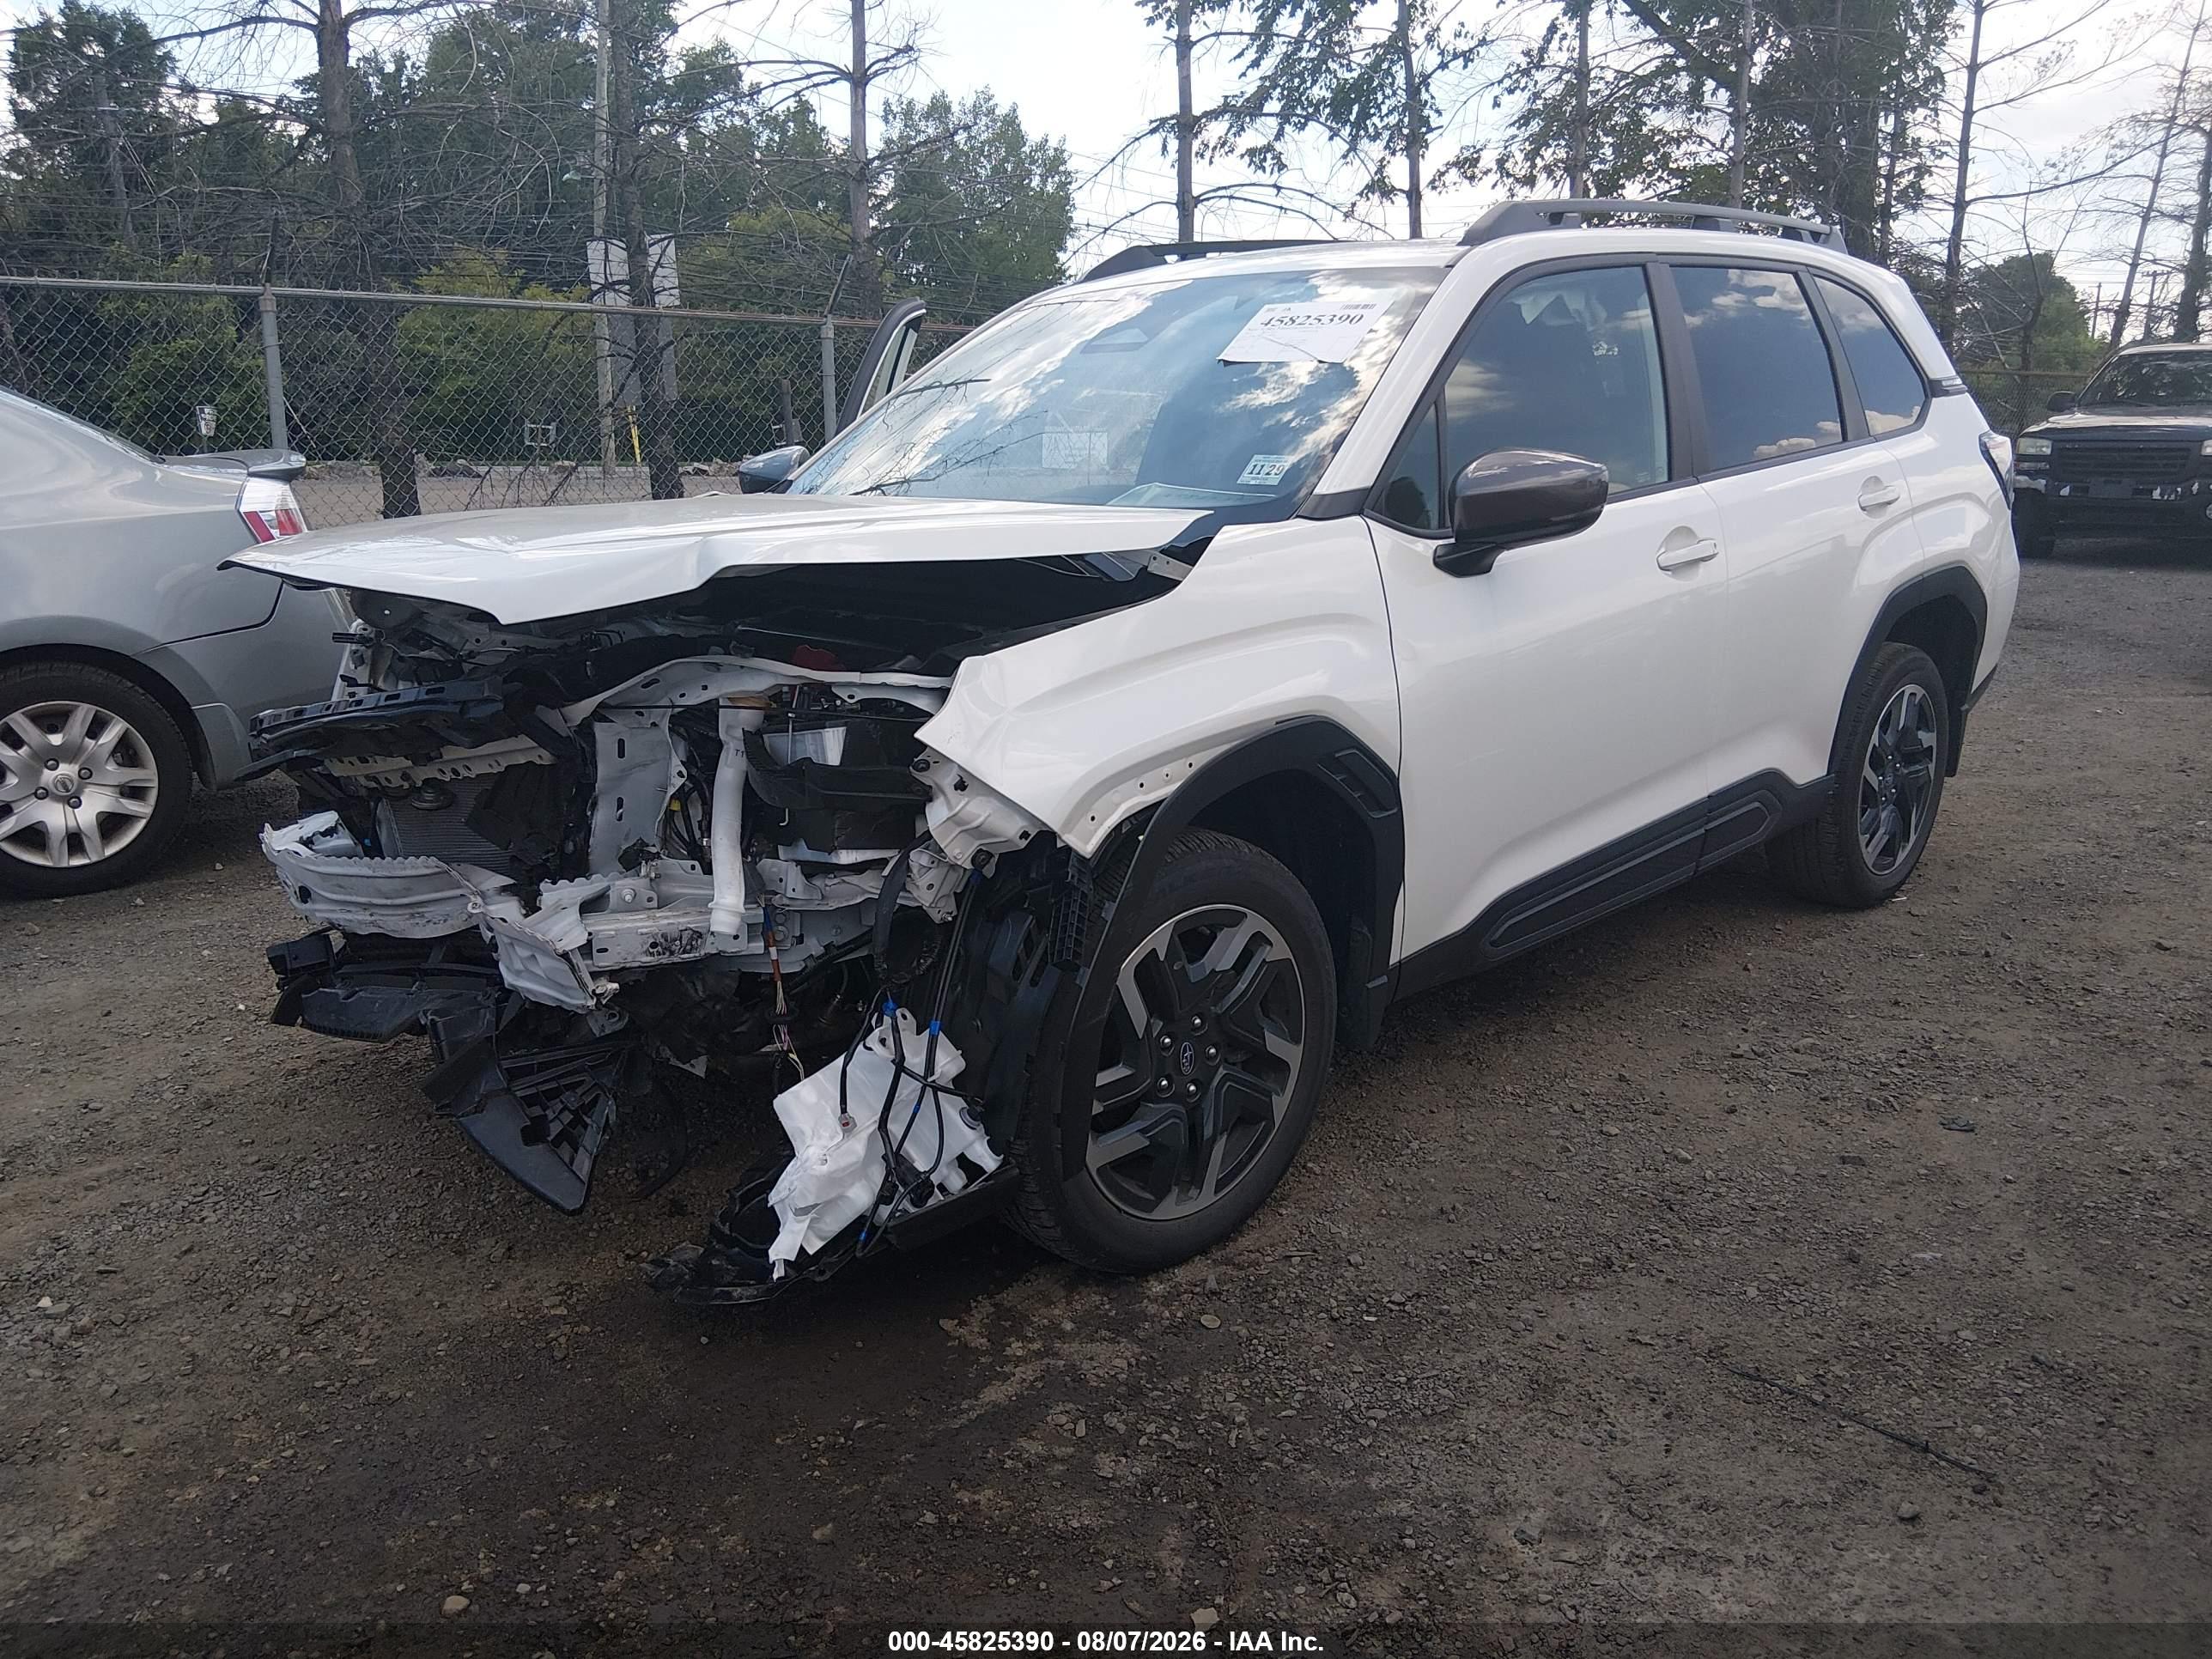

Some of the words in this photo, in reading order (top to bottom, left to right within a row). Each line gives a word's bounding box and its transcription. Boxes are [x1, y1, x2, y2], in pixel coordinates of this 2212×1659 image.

[1260, 313, 1364, 327] 45825390
[1247, 464, 1266, 476] 11
[1264, 464, 1285, 476] 29
